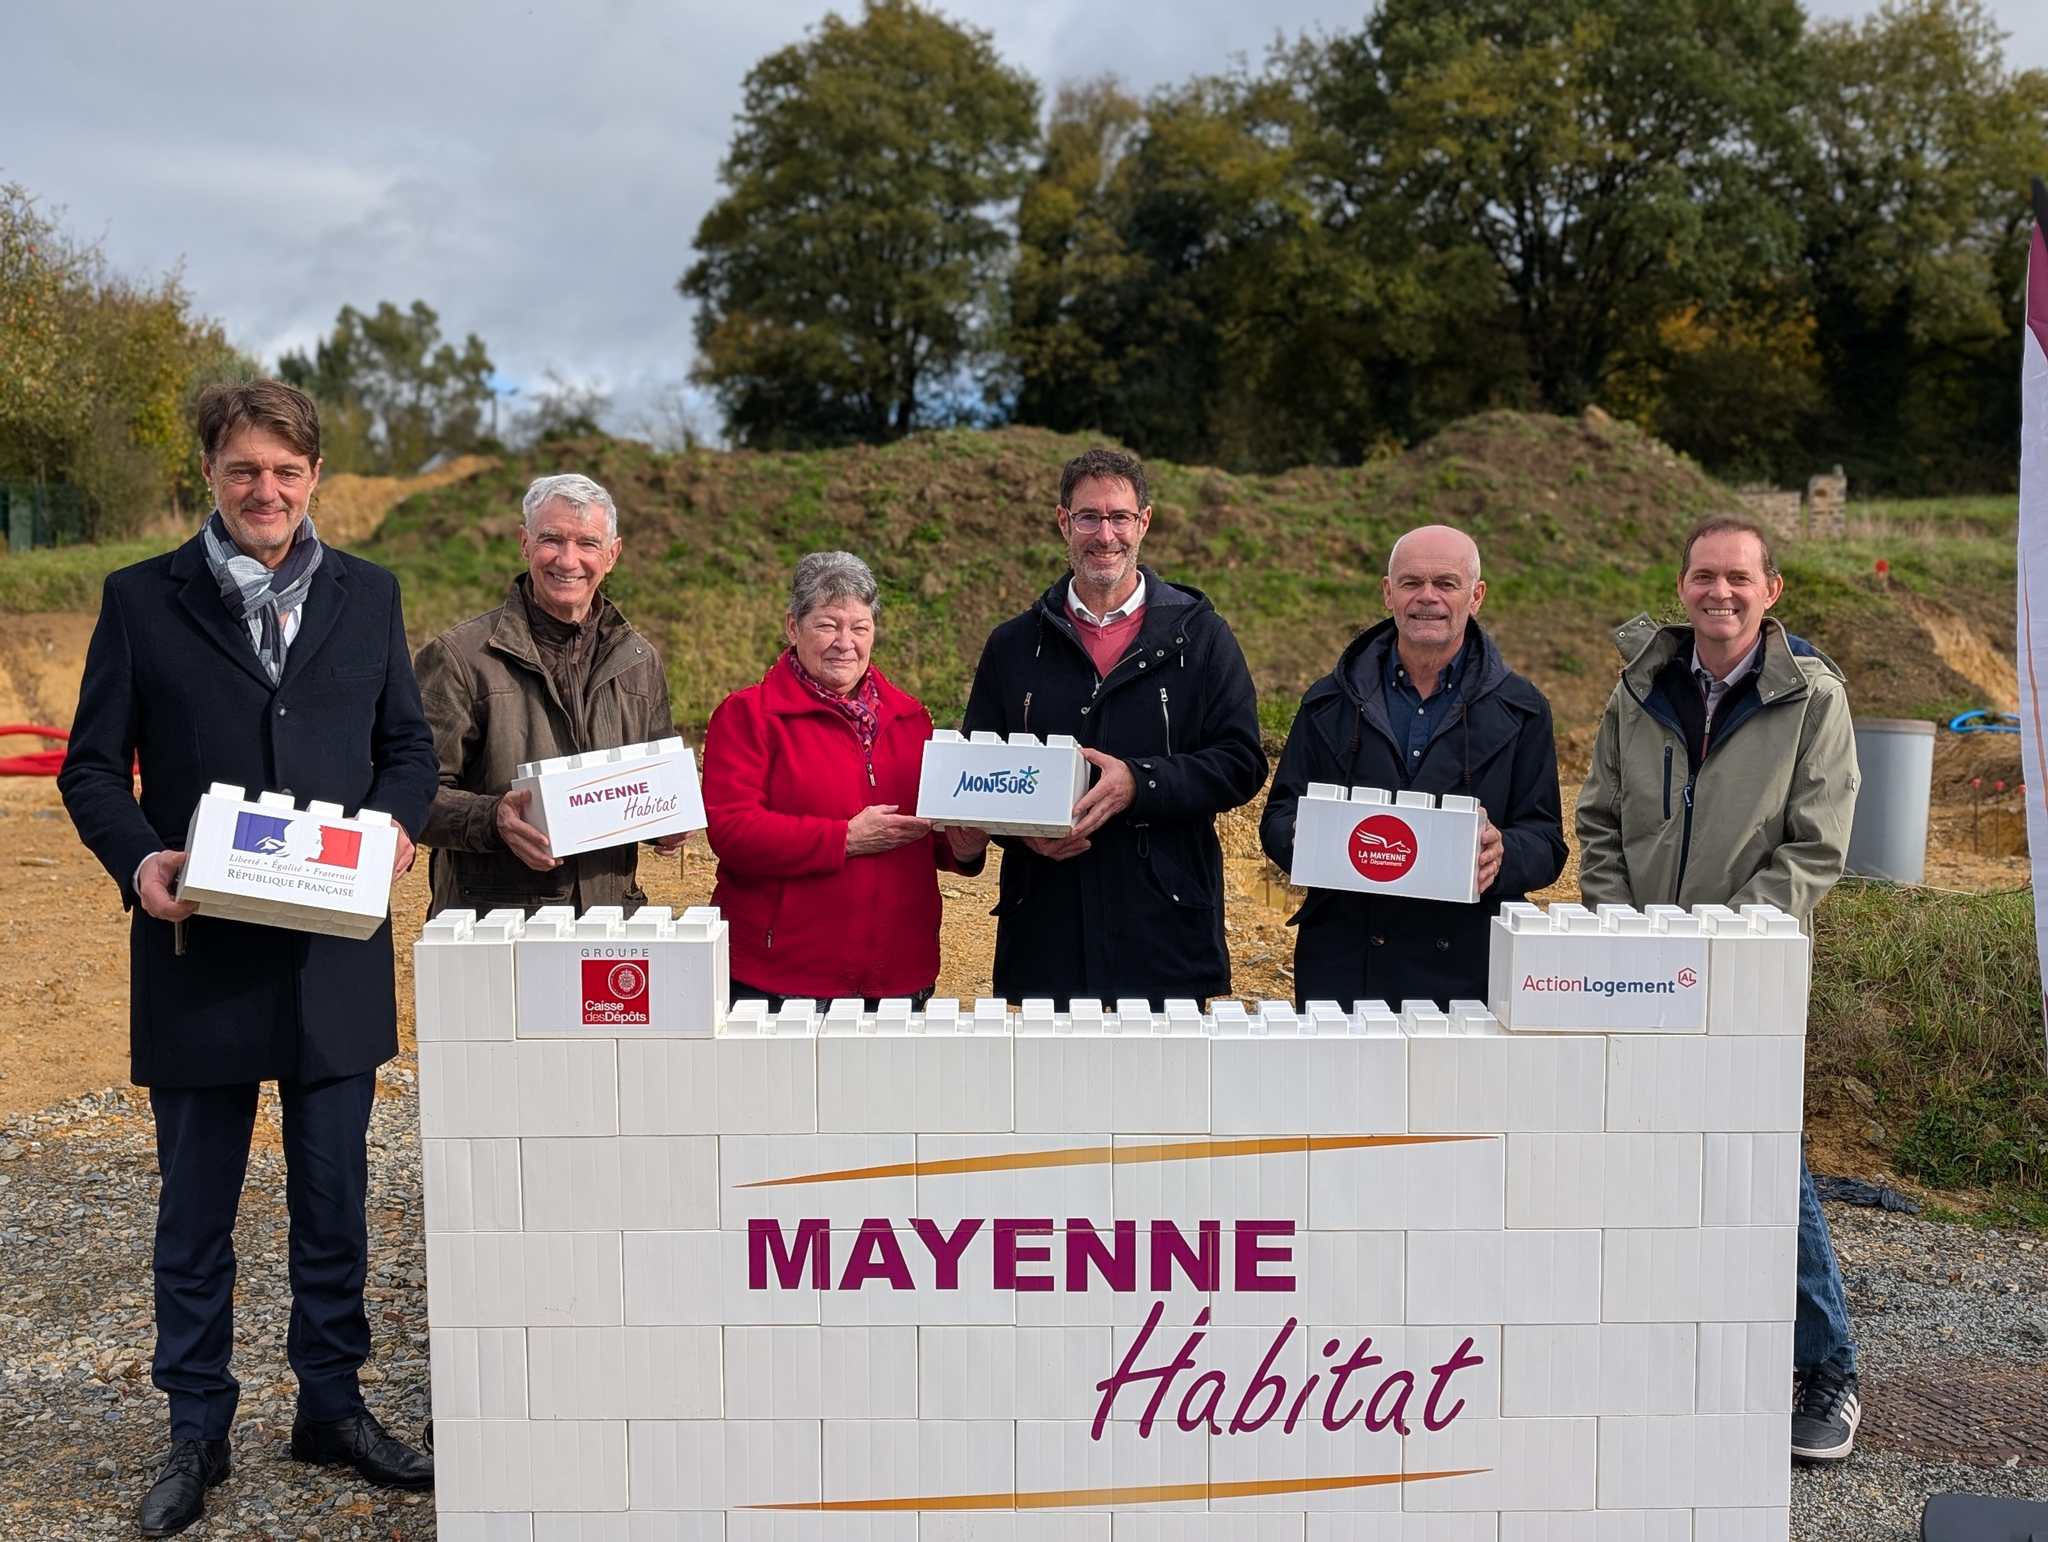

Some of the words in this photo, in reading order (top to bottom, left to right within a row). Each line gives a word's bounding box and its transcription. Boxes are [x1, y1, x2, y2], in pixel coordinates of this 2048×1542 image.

[569, 781, 650, 808] MAYENNE
[623, 794, 678, 821] Habitat
[229, 853, 261, 866] Liberté
[271, 859, 303, 873] Égalité
[313, 867, 357, 882] Fraternité
[1358, 850, 1368, 858] LA
[1370, 851, 1407, 862] MAYENNE
[1370, 858, 1403, 867] Département
[227, 868, 294, 888] RÉPUBLIQUE
[297, 879, 355, 897] FRANÇAISE
[581, 948, 650, 958] GROUPE
[1522, 974, 1676, 998] ActionLogement
[584, 1000, 625, 1011] Caisse
[747, 1218, 1297, 1294] MAYENNE
[1091, 1300, 1485, 1442] Habitat
